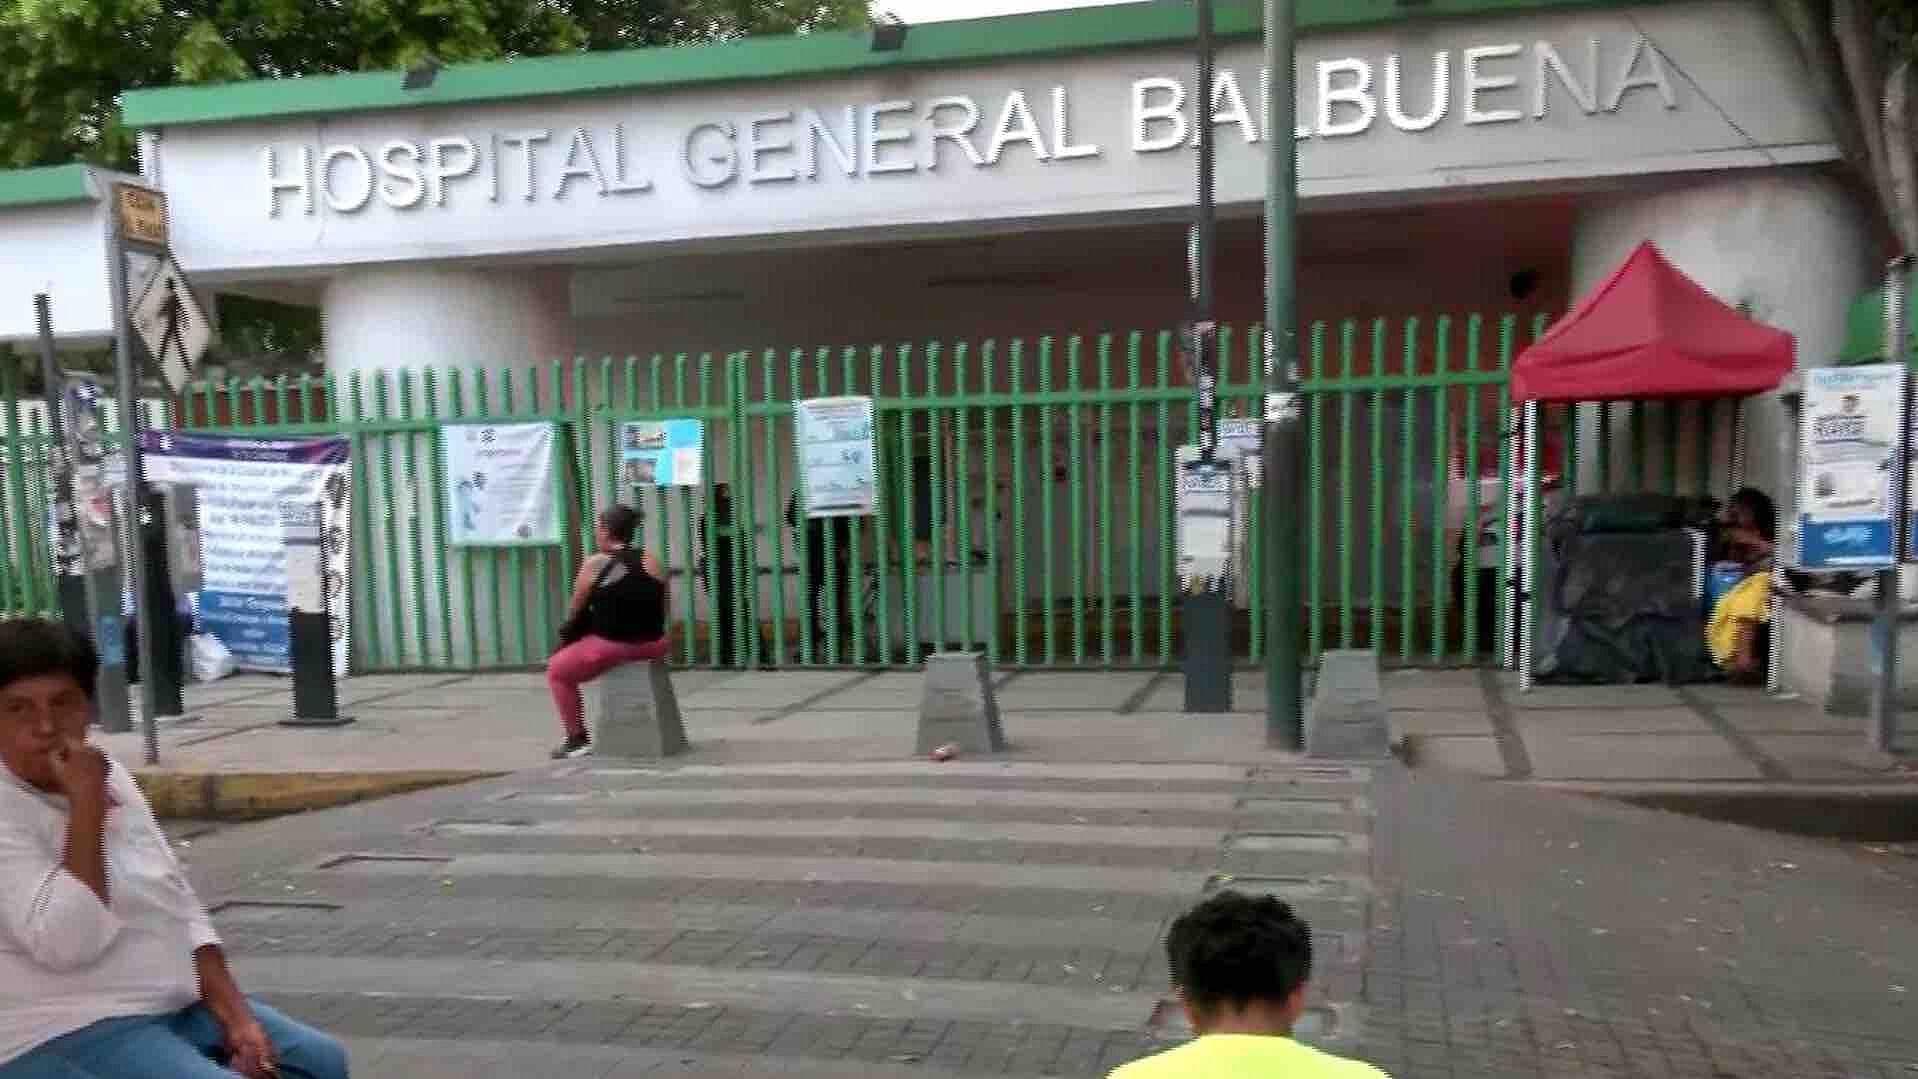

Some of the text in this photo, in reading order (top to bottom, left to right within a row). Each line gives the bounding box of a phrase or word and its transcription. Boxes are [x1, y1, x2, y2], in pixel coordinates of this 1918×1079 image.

[264, 33, 1678, 218] HOSPITAL GENERAL BALBUENA
